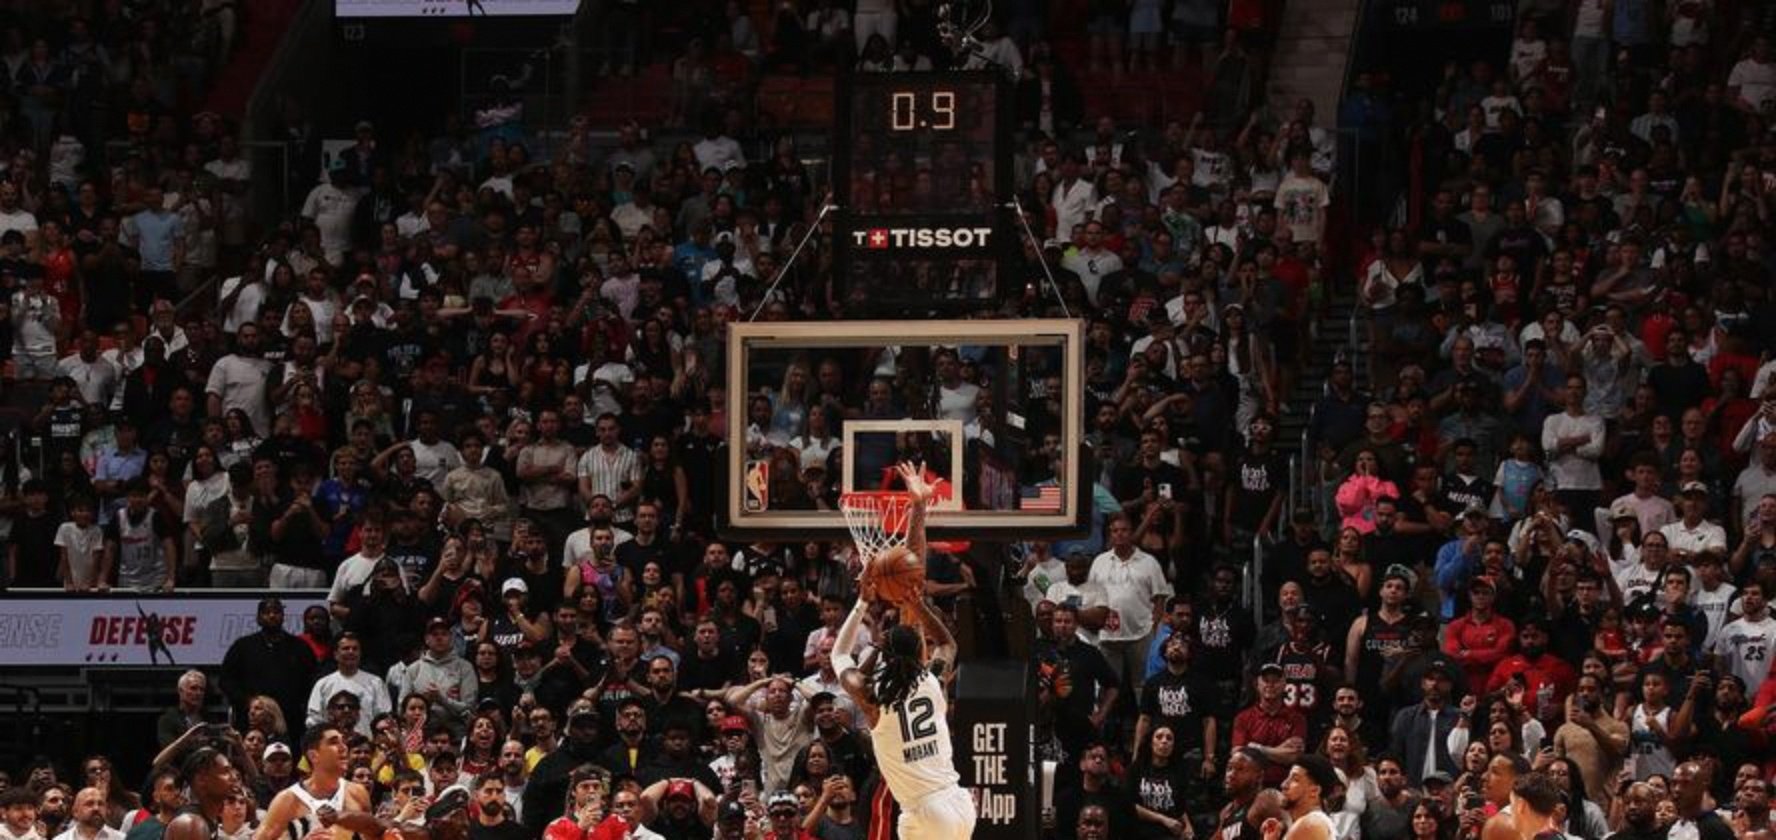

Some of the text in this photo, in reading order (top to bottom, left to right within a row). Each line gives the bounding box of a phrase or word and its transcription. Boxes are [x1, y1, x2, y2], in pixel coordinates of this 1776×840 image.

[893, 91, 955, 130] 0.9
[890, 227, 992, 248] TISSOT
[1282, 683, 1317, 708] 33
[893, 696, 938, 743] 12
[902, 739, 940, 763] MORANT
[972, 722, 1008, 753] GET
[972, 755, 1008, 785] THE
[981, 787, 1016, 825] App
